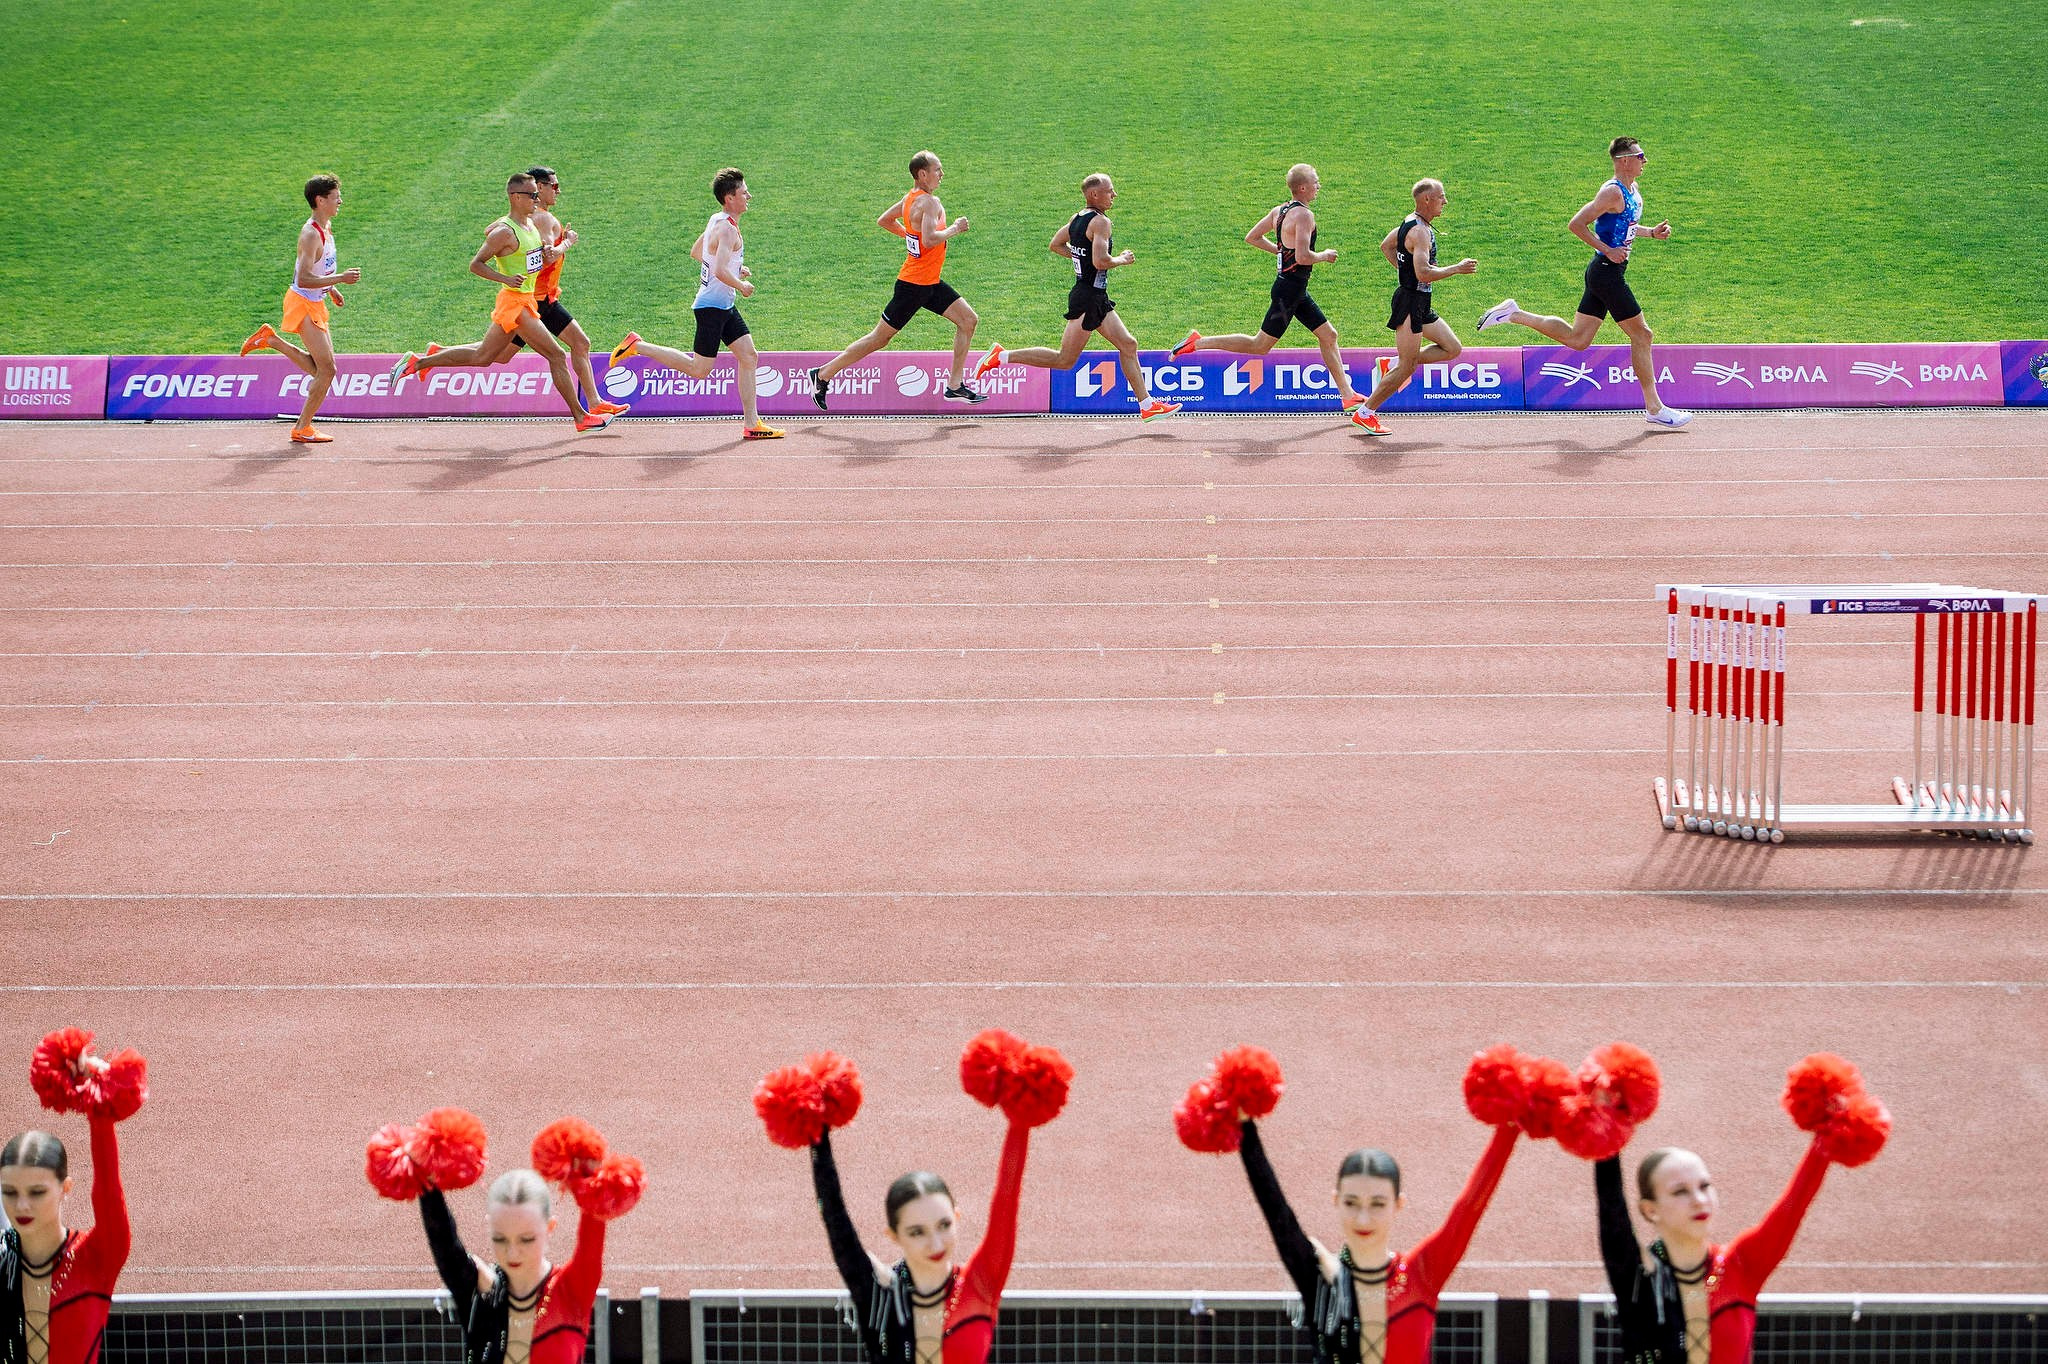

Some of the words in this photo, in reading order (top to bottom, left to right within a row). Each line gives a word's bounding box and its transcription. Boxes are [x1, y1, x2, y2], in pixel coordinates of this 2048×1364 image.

[5, 366, 72, 390] URAL
[642, 368, 735, 378] БАЛТИКИЙ
[788, 367, 881, 378] БАСКИЙ
[934, 367, 1027, 378] БАТИСКИЙ
[1423, 363, 1501, 388] ПСБ
[1608, 366, 1676, 384] ВФА
[1760, 365, 1829, 383] ВФЛА
[1919, 363, 1988, 382] ВФЛА
[122, 374, 259, 398] FONBET
[426, 372, 553, 396] FONBET
[640, 379, 735, 395] ЛИЗИНГ
[932, 378, 1027, 395] ЛЗИНГ
[3, 393, 71, 405] LOGISTICS
[1838, 601, 1864, 611] ПСБ
[1951, 600, 1991, 611] ВФЛА
